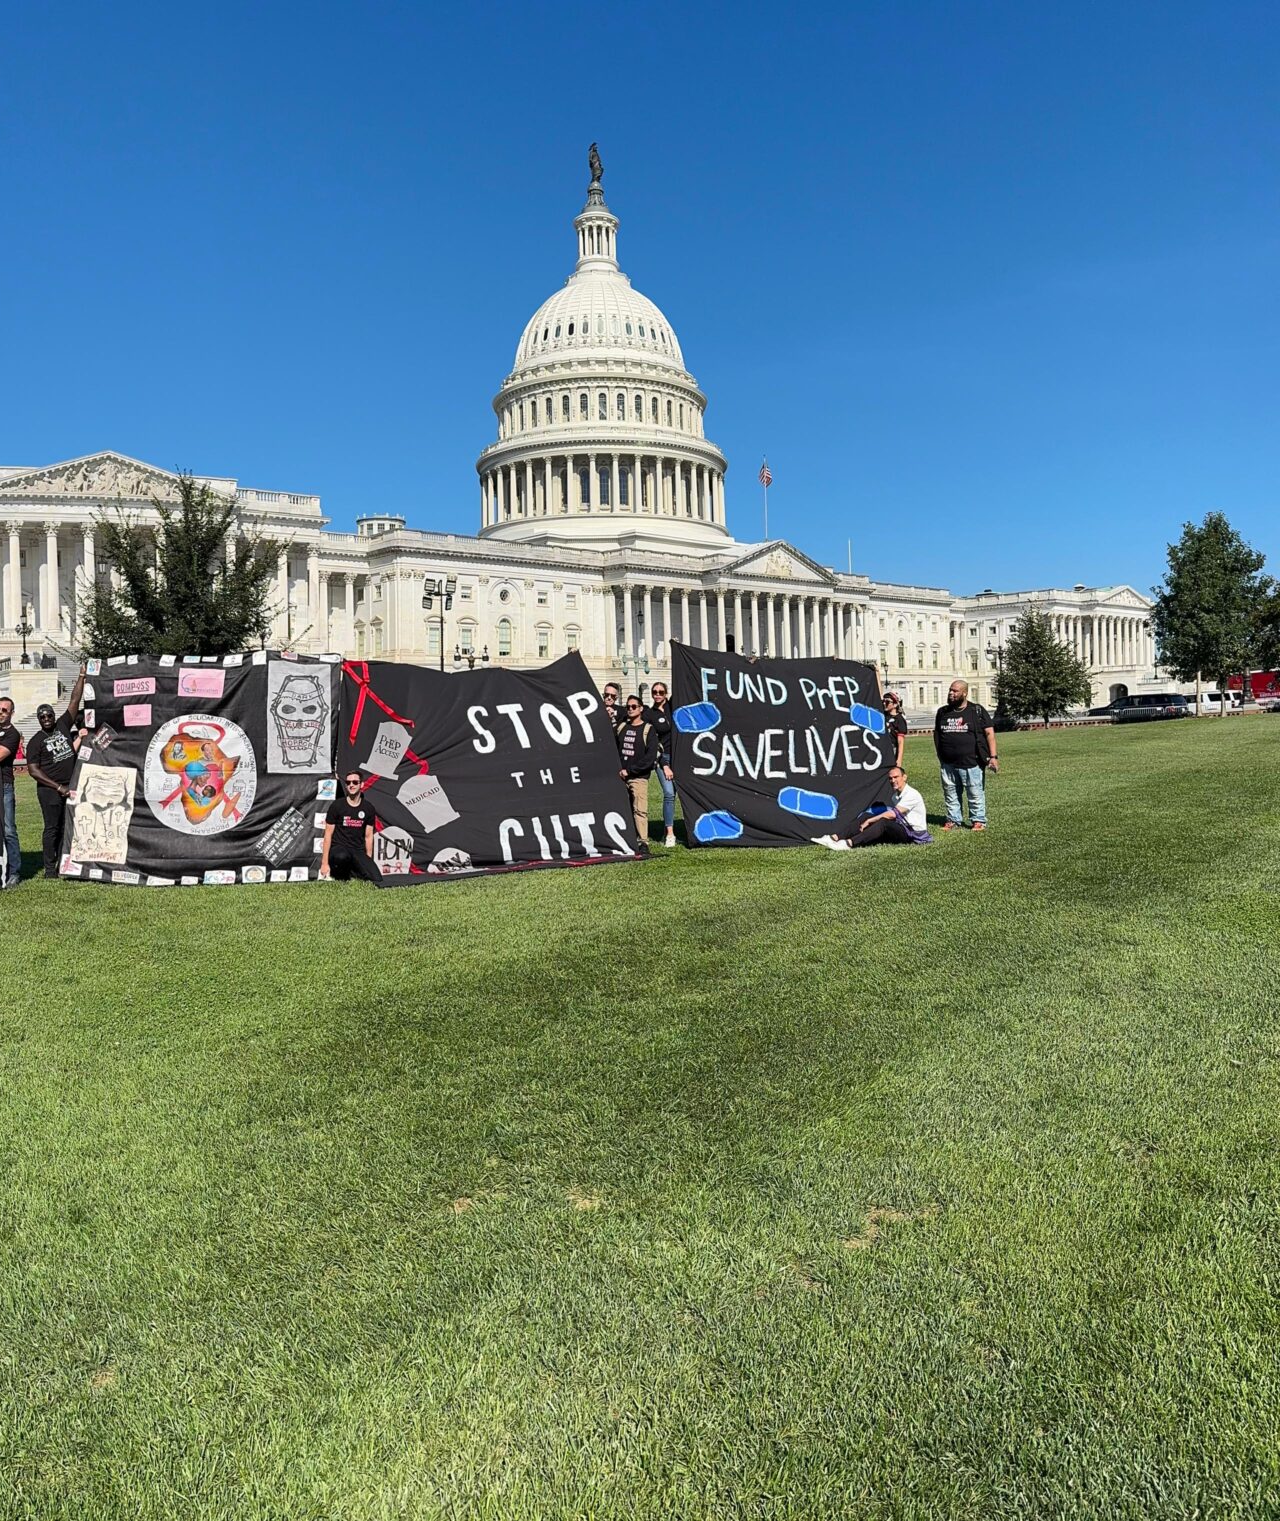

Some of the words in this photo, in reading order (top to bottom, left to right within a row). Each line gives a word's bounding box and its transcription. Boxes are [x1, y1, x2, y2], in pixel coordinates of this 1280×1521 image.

[700, 667, 787, 705] FUND
[799, 676, 860, 712] PrEP
[467, 691, 598, 754] STOP
[511, 766, 581, 788] THE
[405, 786, 440, 807] MEDICAID
